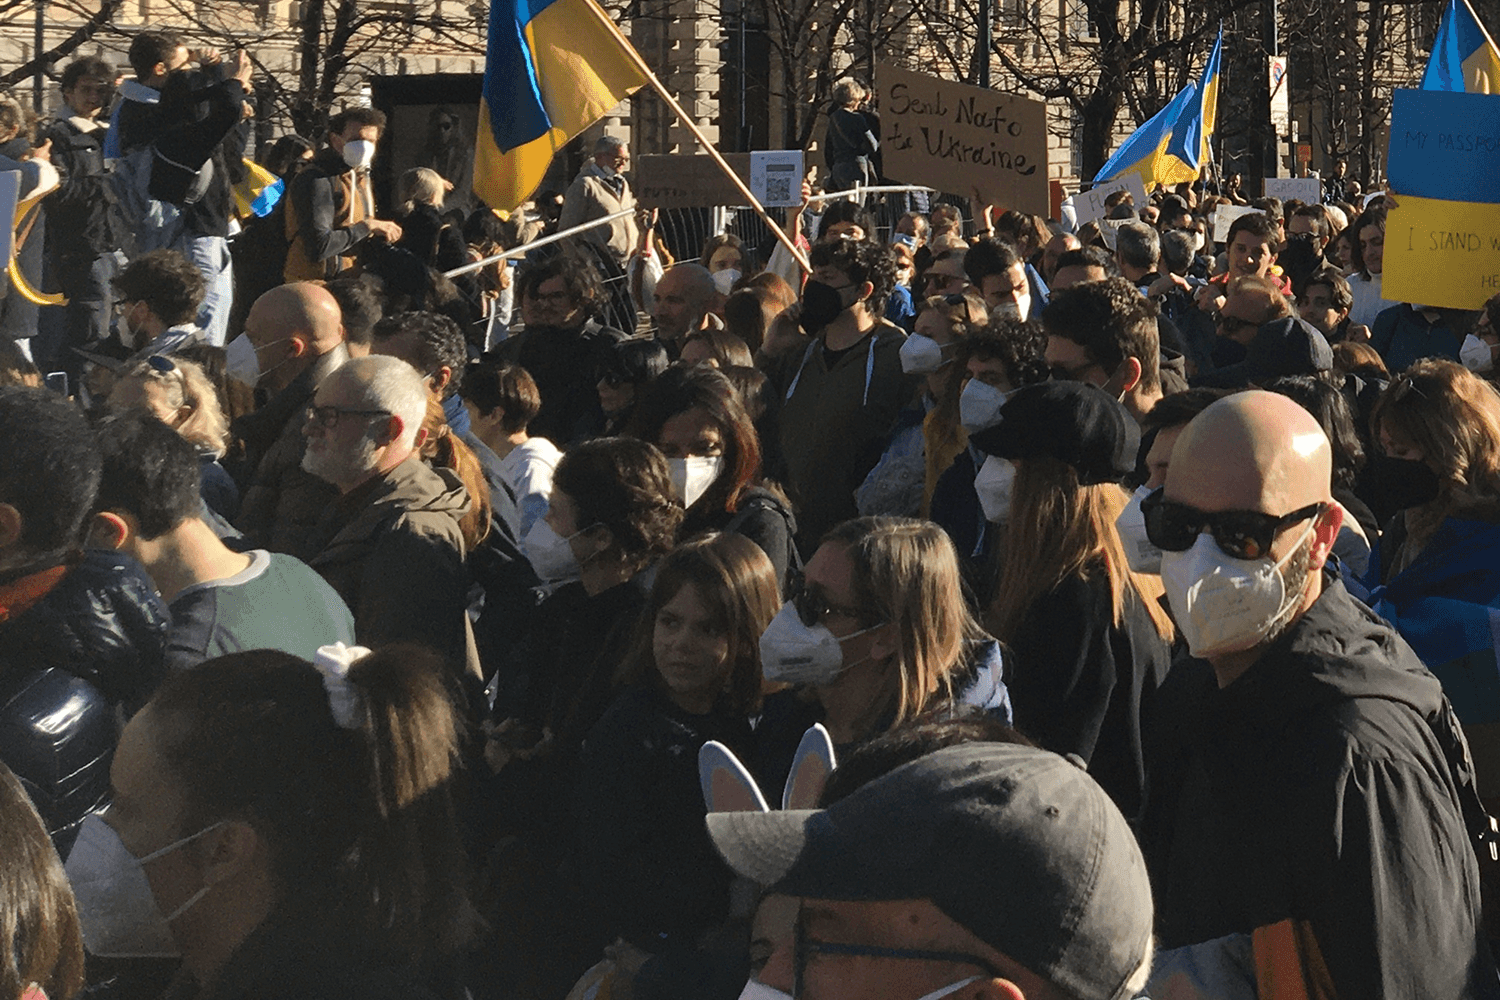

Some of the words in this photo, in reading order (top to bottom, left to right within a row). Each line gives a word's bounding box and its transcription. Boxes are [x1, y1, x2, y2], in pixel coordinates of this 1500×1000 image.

[954, 96, 1022, 137] Nato
[920, 127, 1036, 176] Ukraine
[1405, 130, 1429, 150] MY
[1407, 226, 1415, 251] I
[1429, 231, 1481, 252] STAND
